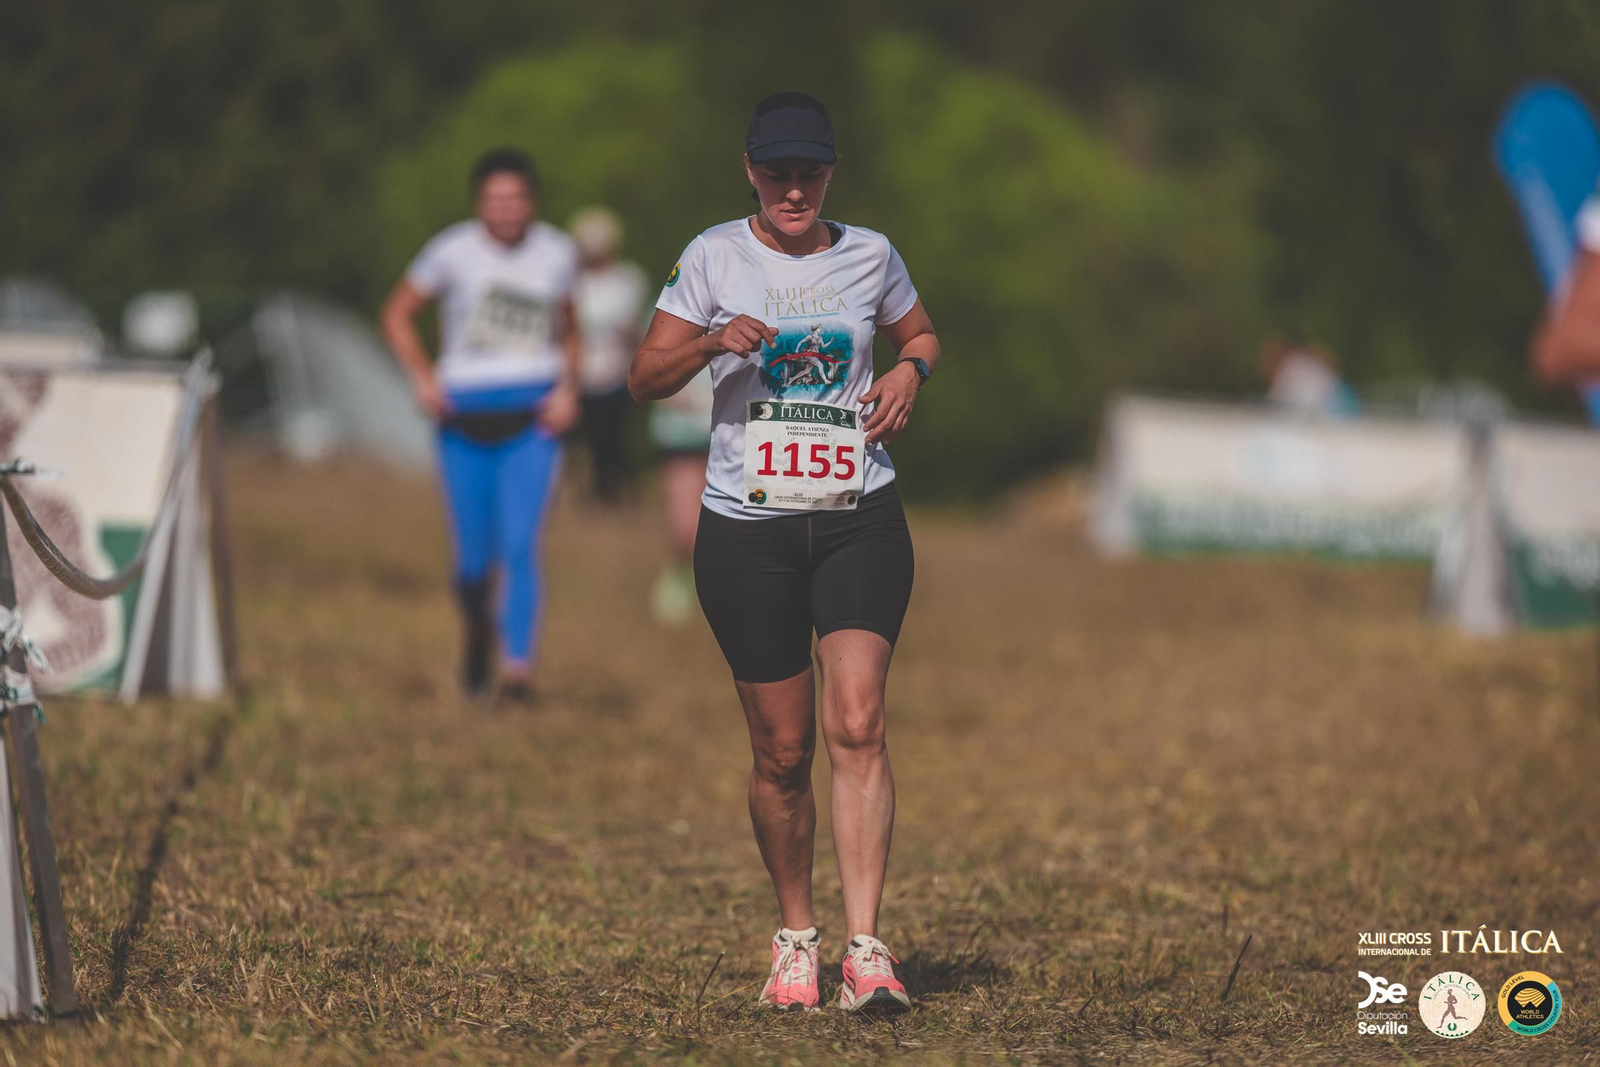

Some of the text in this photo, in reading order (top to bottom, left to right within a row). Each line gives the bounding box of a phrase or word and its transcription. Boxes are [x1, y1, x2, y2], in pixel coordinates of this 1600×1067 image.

[803, 286, 835, 296] CROSS
[780, 405, 834, 421] ITÁLICA
[757, 441, 856, 480] 1155
